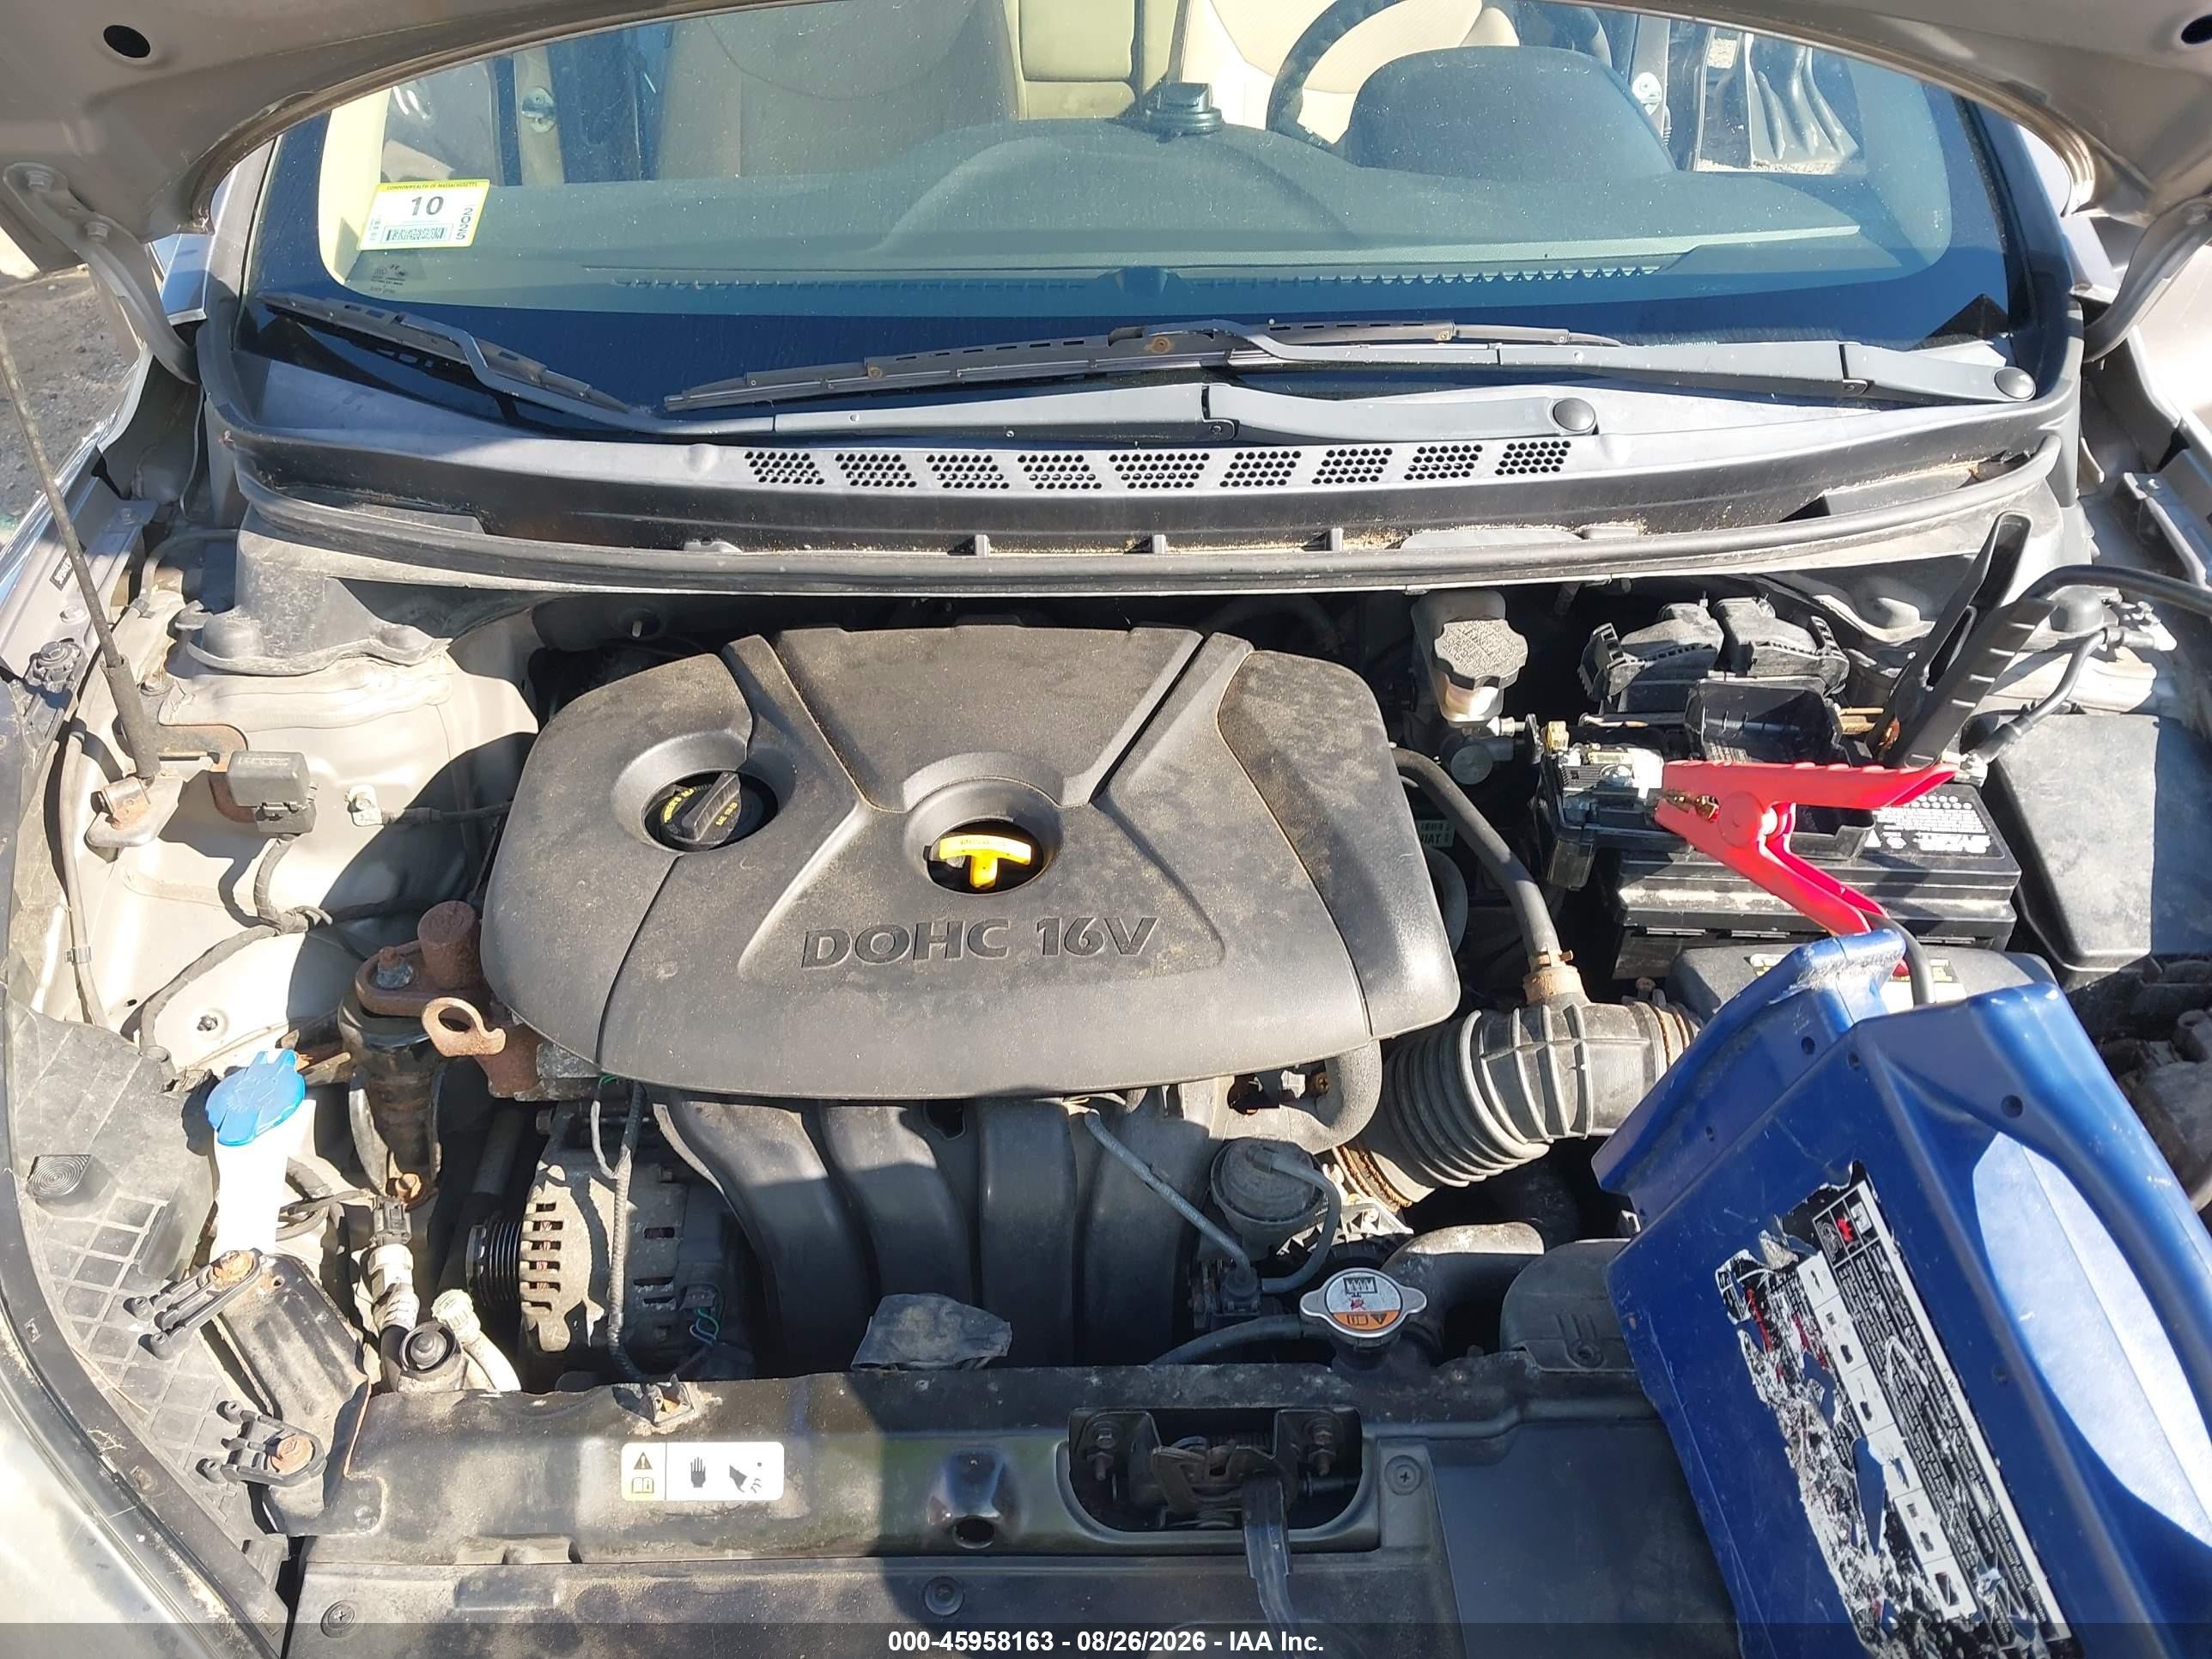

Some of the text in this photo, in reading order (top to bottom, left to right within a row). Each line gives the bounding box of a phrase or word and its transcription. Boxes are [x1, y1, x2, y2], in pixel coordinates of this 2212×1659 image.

[411, 196, 444, 216] 10
[456, 208, 473, 240] 2025
[801, 916, 1159, 969] DOHC 16V
